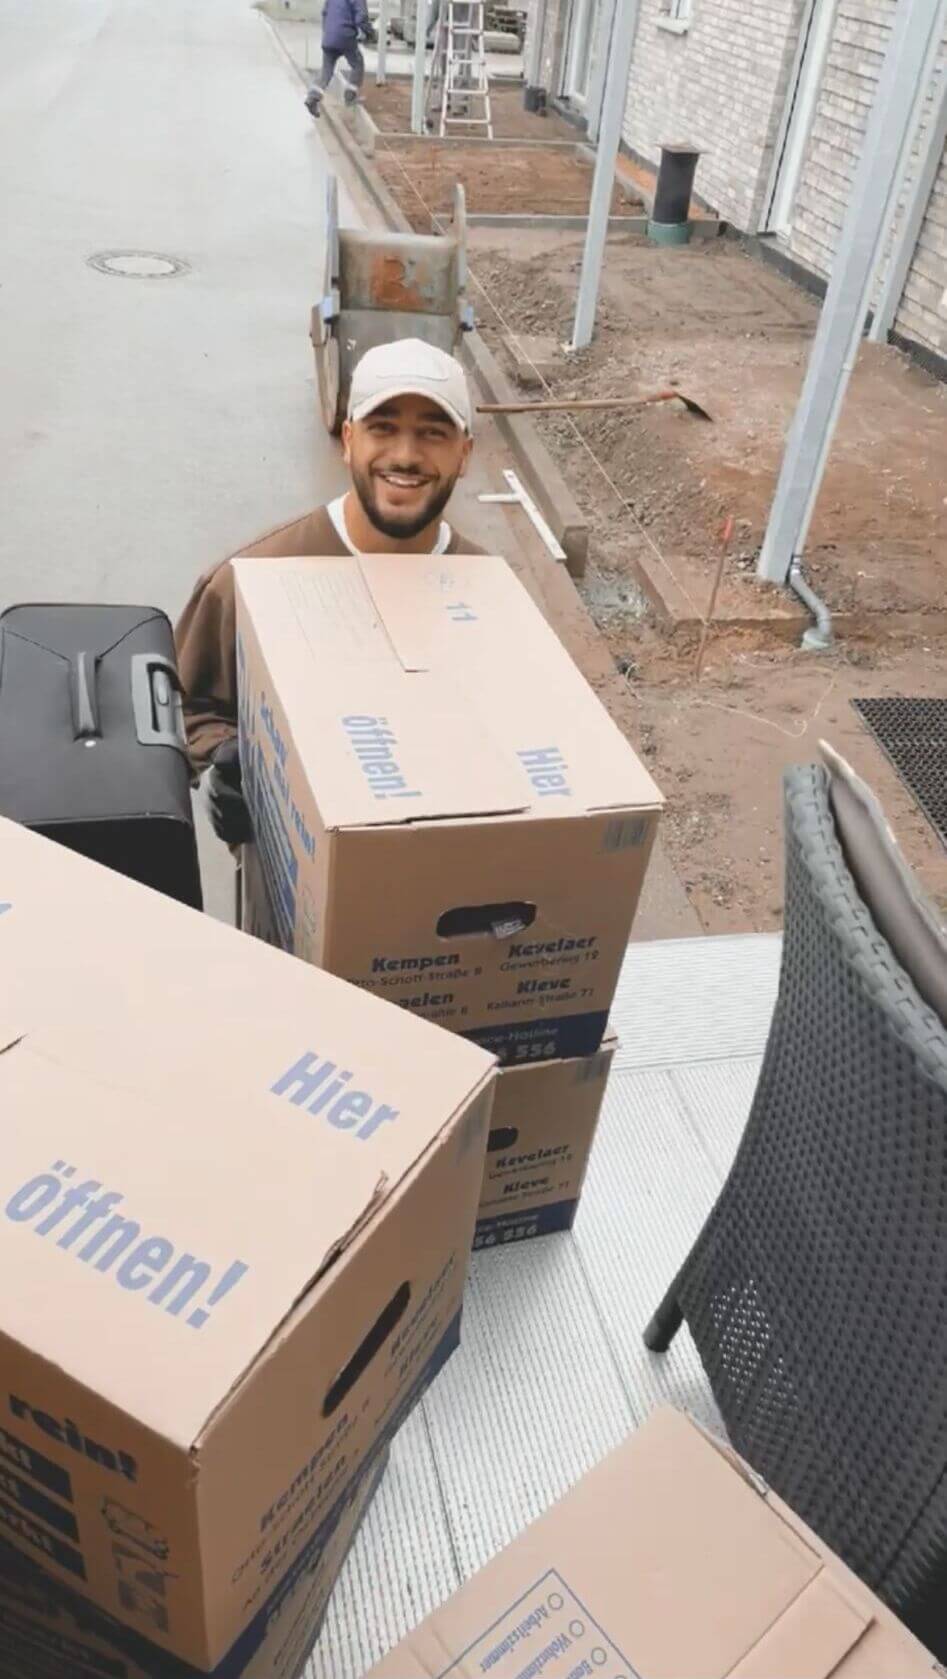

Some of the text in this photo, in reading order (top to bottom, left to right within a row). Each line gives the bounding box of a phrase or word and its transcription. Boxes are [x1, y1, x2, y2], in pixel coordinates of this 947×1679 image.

[342, 714, 423, 800] öffnen!
[515, 746, 575, 798] Hier
[372, 952, 461, 973] Kempen
[508, 936, 598, 958] Kevelaer
[399, 991, 455, 1009] aelen
[516, 977, 572, 995] Kleve
[269, 1050, 399, 1141] Hier
[496, 1144, 570, 1168] Kevelaer
[503, 1177, 551, 1195] Kleve
[4, 1159, 249, 1329] öffnen!
[9, 1393, 138, 1484] rein!
[479, 1604, 549, 1673] Arbeitszimmer
